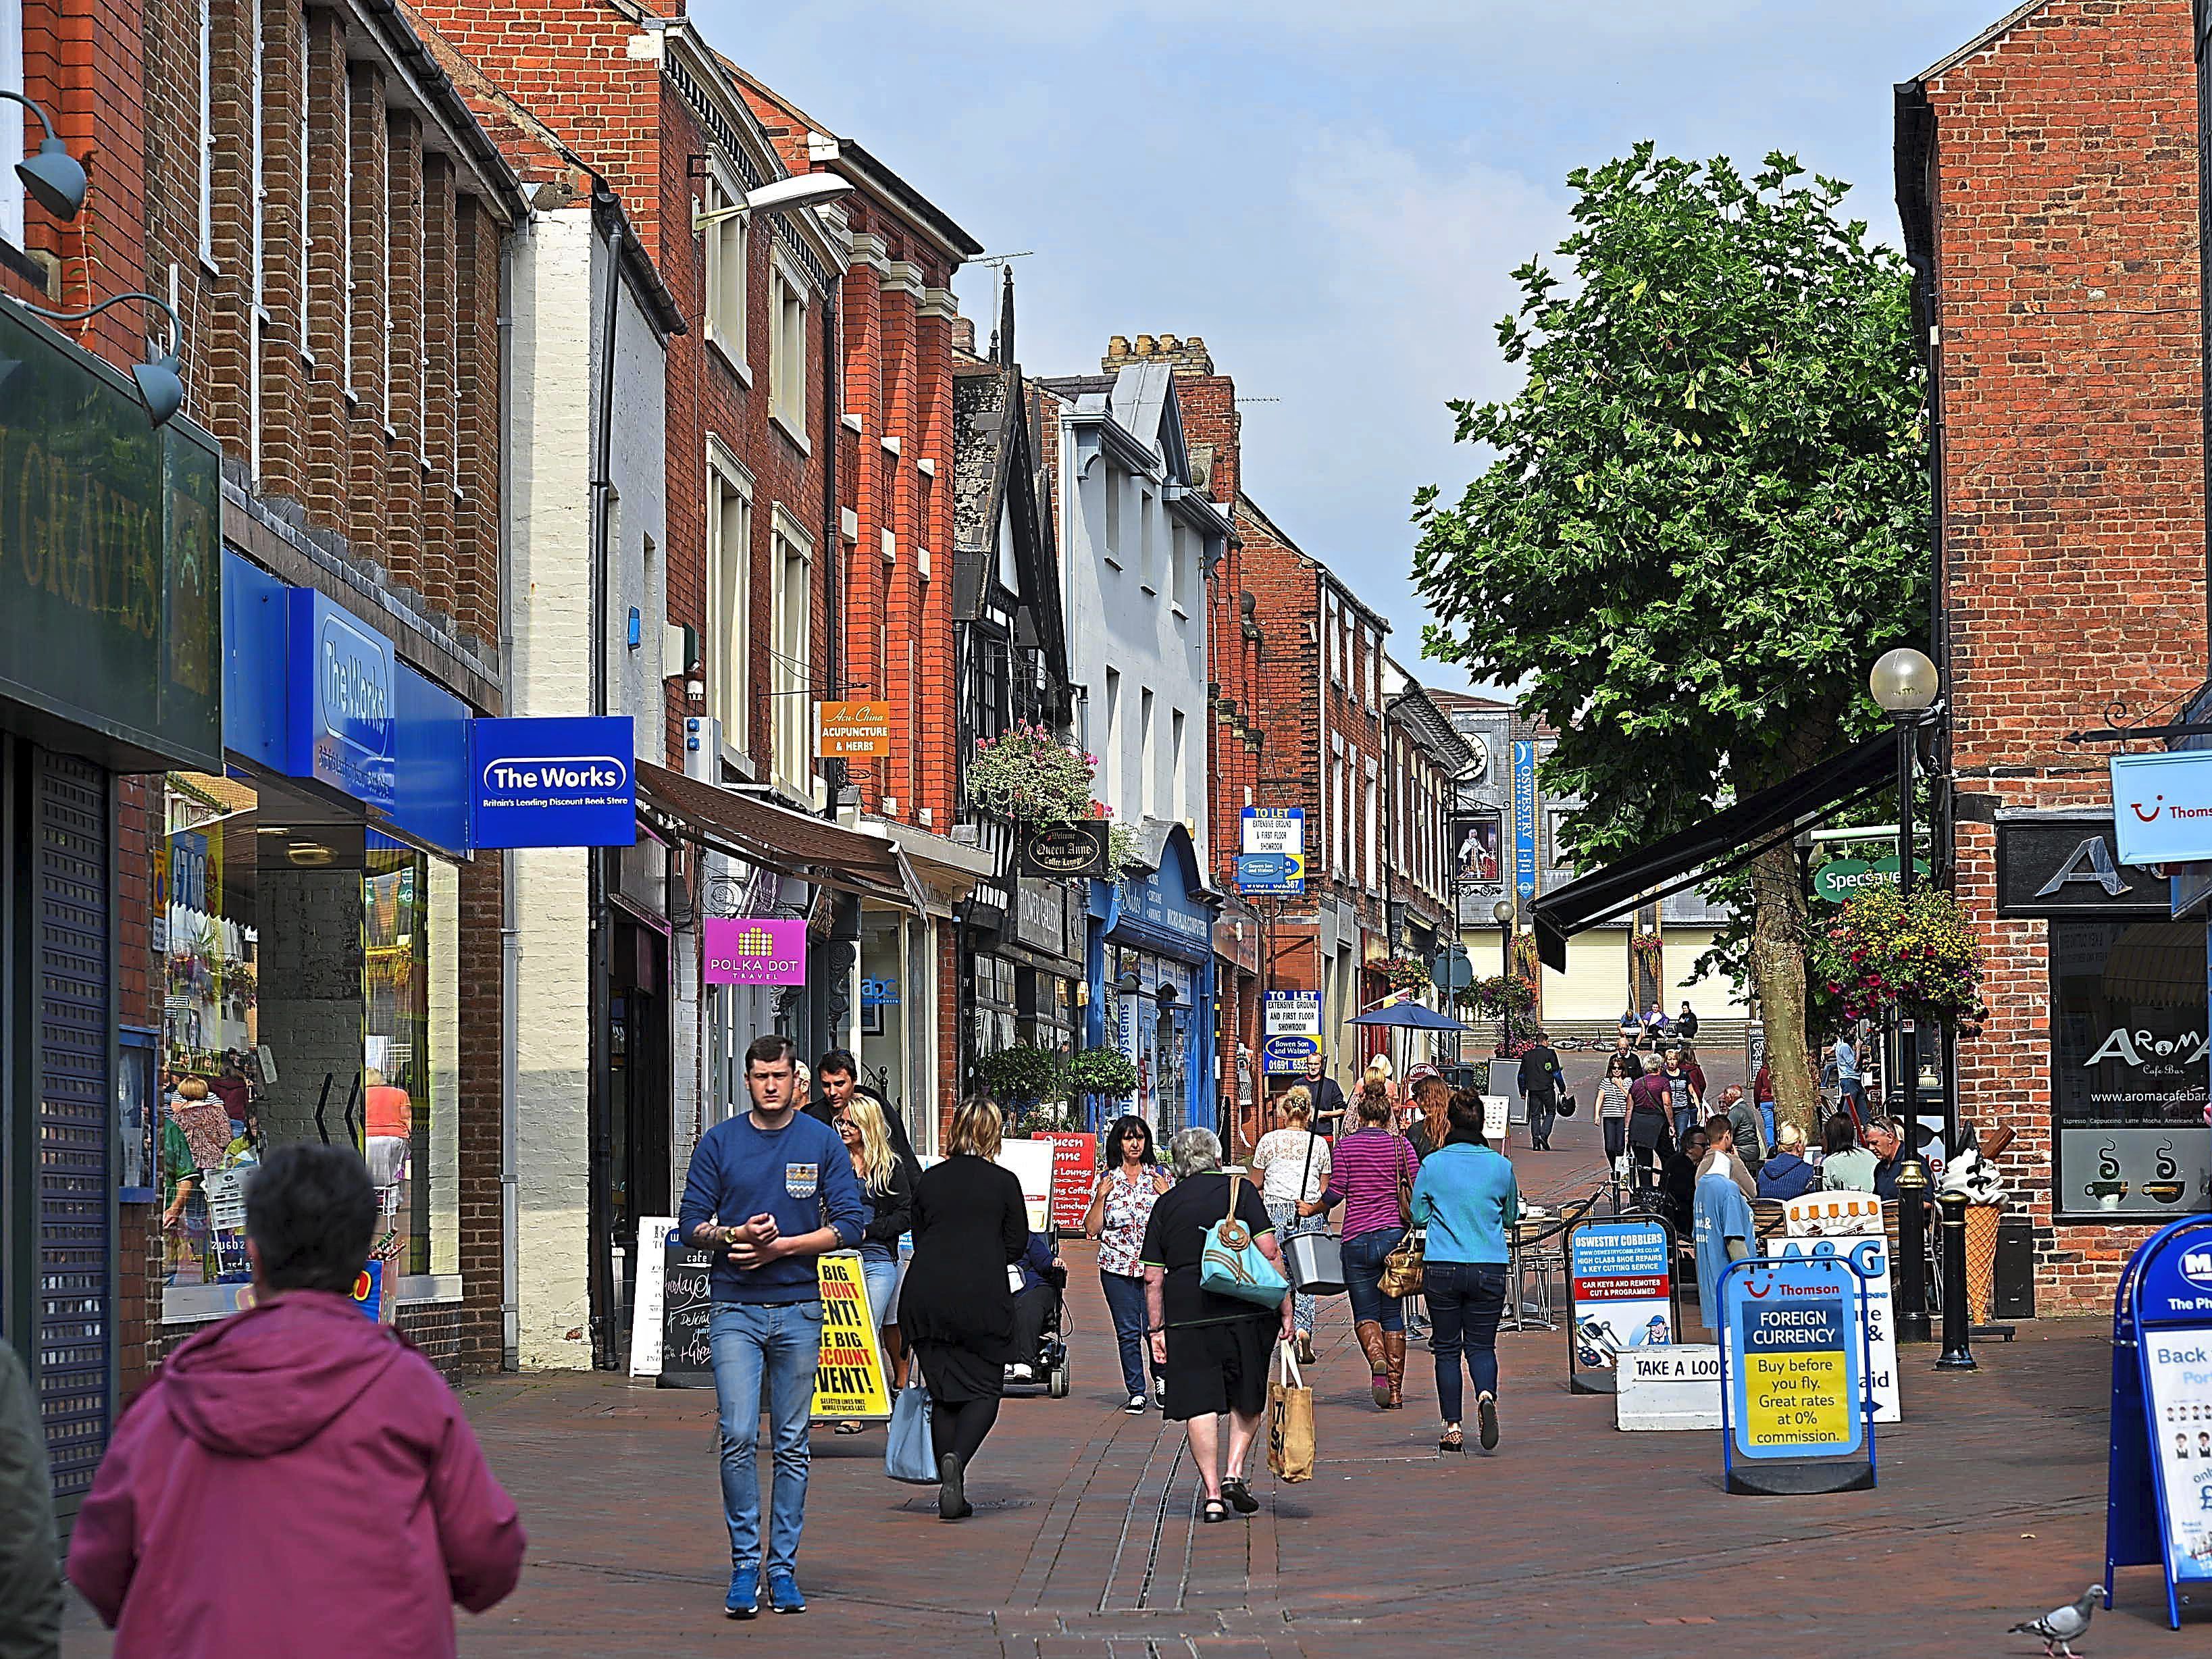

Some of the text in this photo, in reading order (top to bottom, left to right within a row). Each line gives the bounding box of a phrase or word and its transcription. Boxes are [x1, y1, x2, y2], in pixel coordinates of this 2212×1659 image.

[326, 640, 385, 735] The Works
[825, 705, 884, 722] Acu-China
[822, 727, 888, 737] ACUPUNCTURE
[836, 742, 874, 751] & HERBS
[494, 766, 616, 788] The Works
[483, 796, 627, 807] Britain's Leading Discount Book Store
[1521, 766, 1533, 839] OSWESTRY
[1254, 809, 1289, 818] TO LET
[1037, 842, 1091, 855] Queen Anne
[1045, 857, 1082, 866] Coffee Lounge
[1123, 878, 1141, 915] Shades
[1020, 888, 1058, 932] FLOWER GALLERY
[1167, 908, 1207, 938] MICRO PLUS COMPUTERS
[711, 959, 798, 971] POLKA DOT
[862, 973, 897, 996] abc
[1269, 992, 1316, 1000] TO LET
[1119, 1004, 1133, 1061] systems
[1269, 1060, 1289, 1070] 01691
[2142, 1065, 2186, 1077] Cafe Bar
[1054, 1152, 1081, 1161] nne
[1060, 1168, 1091, 1177] Lounge
[1576, 1233, 1662, 1247] OSWESTRY COBBLERS
[687, 1250, 708, 1262] cafe
[1580, 1248, 1660, 1256] WWW.OSWESTRYCOBBLERS.CO.UK
[822, 1265, 849, 1281] BIG
[820, 1281, 860, 1299] OUNT
[1779, 1284, 1840, 1296] Thomson
[2167, 1298, 2194, 1310] The
[821, 1300, 862, 1326] ENT!
[1760, 1311, 1826, 1326] FOREIGN
[835, 1332, 863, 1347] BIG
[1753, 1329, 1836, 1344] CURRENCY
[1869, 1325, 1885, 1341] &
[818, 1347, 872, 1365] SCOUNT
[2158, 1347, 2207, 1364] Back
[1637, 1360, 1669, 1376] TAKE
[1675, 1360, 1684, 1376] A
[1758, 1358, 1832, 1375] Buy before
[815, 1367, 875, 1394] VENT!
[1772, 1377, 1820, 1393] you fly.
[1759, 1394, 1834, 1408] Great rates
[1778, 1412, 1818, 1425] at 0%
[1757, 1429, 1840, 1444] commission.
